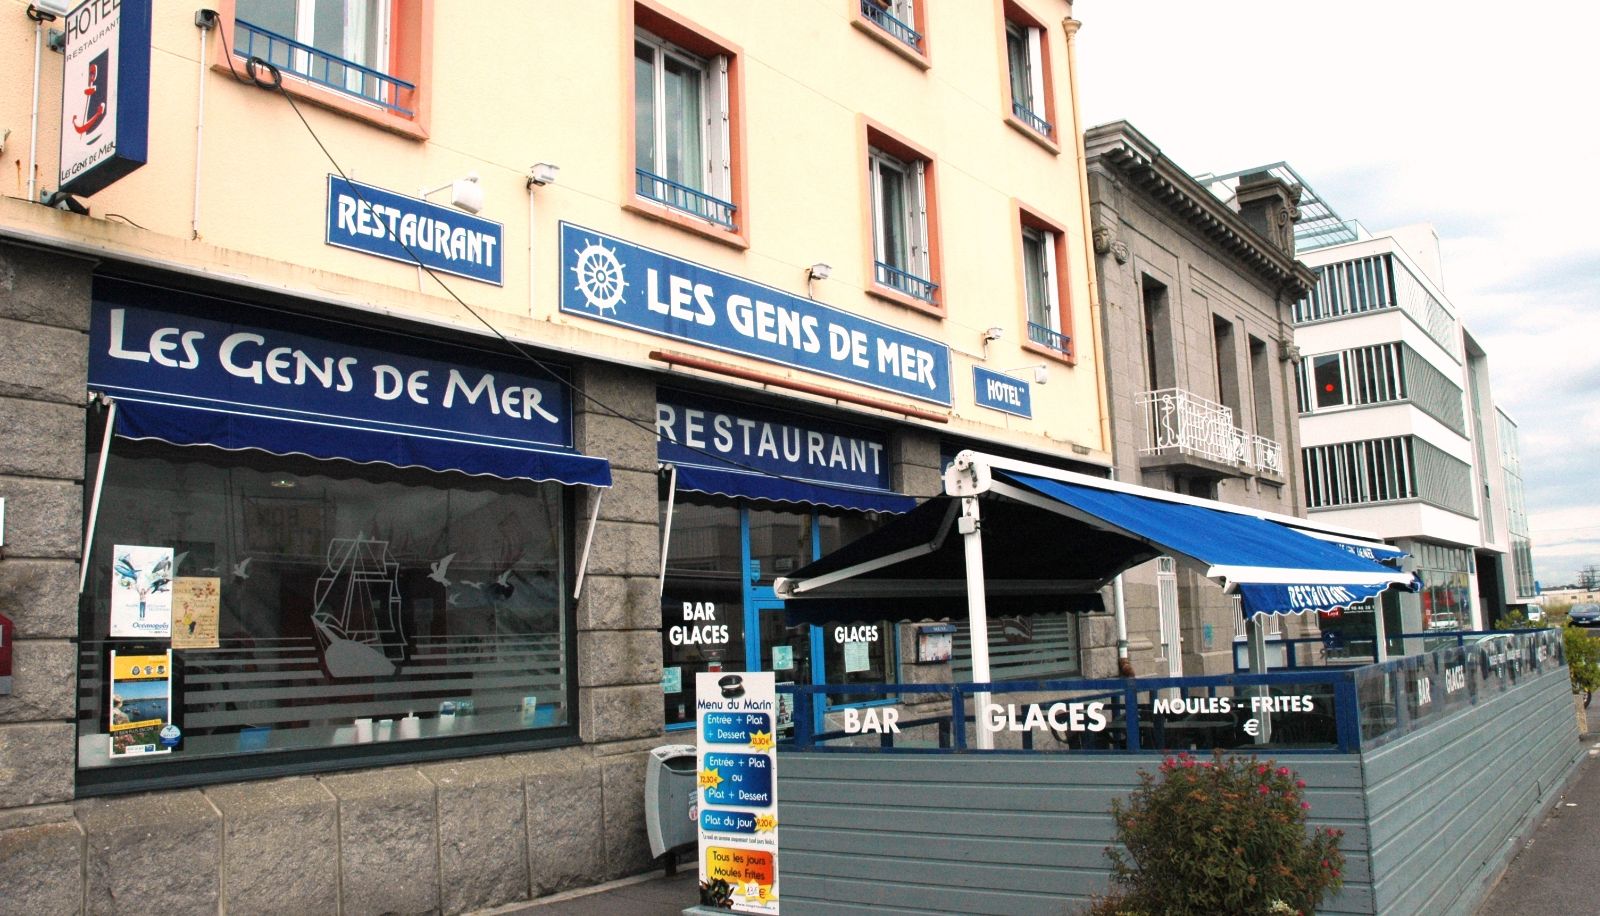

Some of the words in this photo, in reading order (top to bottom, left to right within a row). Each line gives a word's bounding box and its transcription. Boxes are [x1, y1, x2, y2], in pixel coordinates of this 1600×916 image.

[66, 17, 120, 62] RESTAURANT
[338, 194, 497, 268] RESTAURANT
[647, 267, 716, 326] LES
[726, 293, 821, 354] GENS
[828, 323, 870, 368] DE
[876, 337, 938, 391] MER
[108, 308, 205, 369] LES
[218, 331, 358, 392] GENS
[373, 364, 430, 405] DE
[442, 368, 560, 423] MER
[656, 403, 883, 475] RESTAURANT
[1287, 585, 1357, 609] RESTAURANT
[683, 602, 716, 621] BAR
[669, 624, 729, 646] GLACES
[834, 625, 878, 645] GLACES
[1445, 664, 1465, 694] GLACES
[1417, 677, 1431, 706] BAR
[698, 699, 723, 710] Menu
[728, 699, 740, 710] du
[1153, 696, 1231, 715] MOULES
[1251, 694, 1315, 713] FRITES
[708, 714, 732, 724] Entrée
[746, 714, 763, 725] Plat
[844, 707, 901, 735] BAR
[982, 701, 1107, 733] GLACES
[717, 730, 746, 740] Dessert
[1243, 718, 1260, 737] €
[709, 756, 735, 767] Entrée
[748, 757, 766, 768] Plat
[731, 774, 743, 782] ou
[708, 788, 724, 799] Plat
[738, 789, 768, 801] Dessert
[705, 814, 721, 825] Plat
[723, 816, 735, 826] du
[736, 817, 753, 829] jour
[713, 850, 730, 861] Tous
[733, 853, 744, 863] les
[746, 855, 766, 866] jours
[714, 866, 742, 878] Moules
[744, 868, 765, 880] Frites
